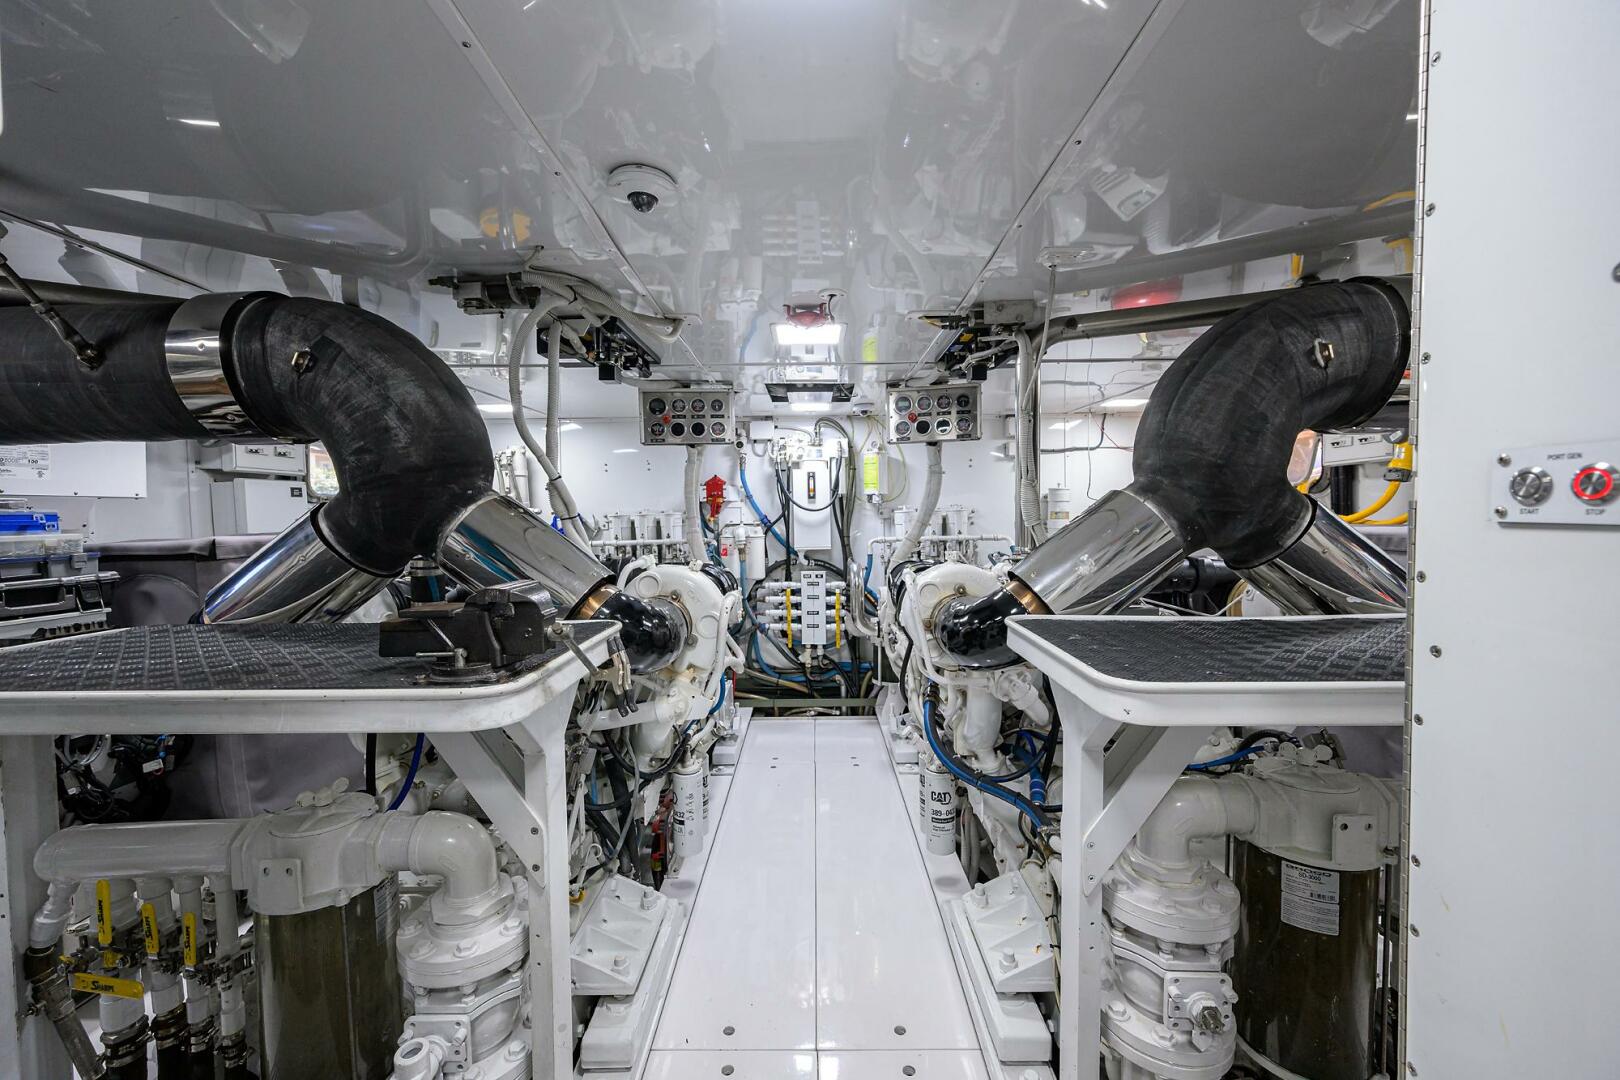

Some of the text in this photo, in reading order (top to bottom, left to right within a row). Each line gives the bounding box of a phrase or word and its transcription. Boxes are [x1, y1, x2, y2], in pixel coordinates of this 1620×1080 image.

[1567, 452, 1583, 460] GEN
[1520, 507, 1540, 515] START
[1585, 508, 1606, 516] STOP
[931, 791, 952, 805] CAT
